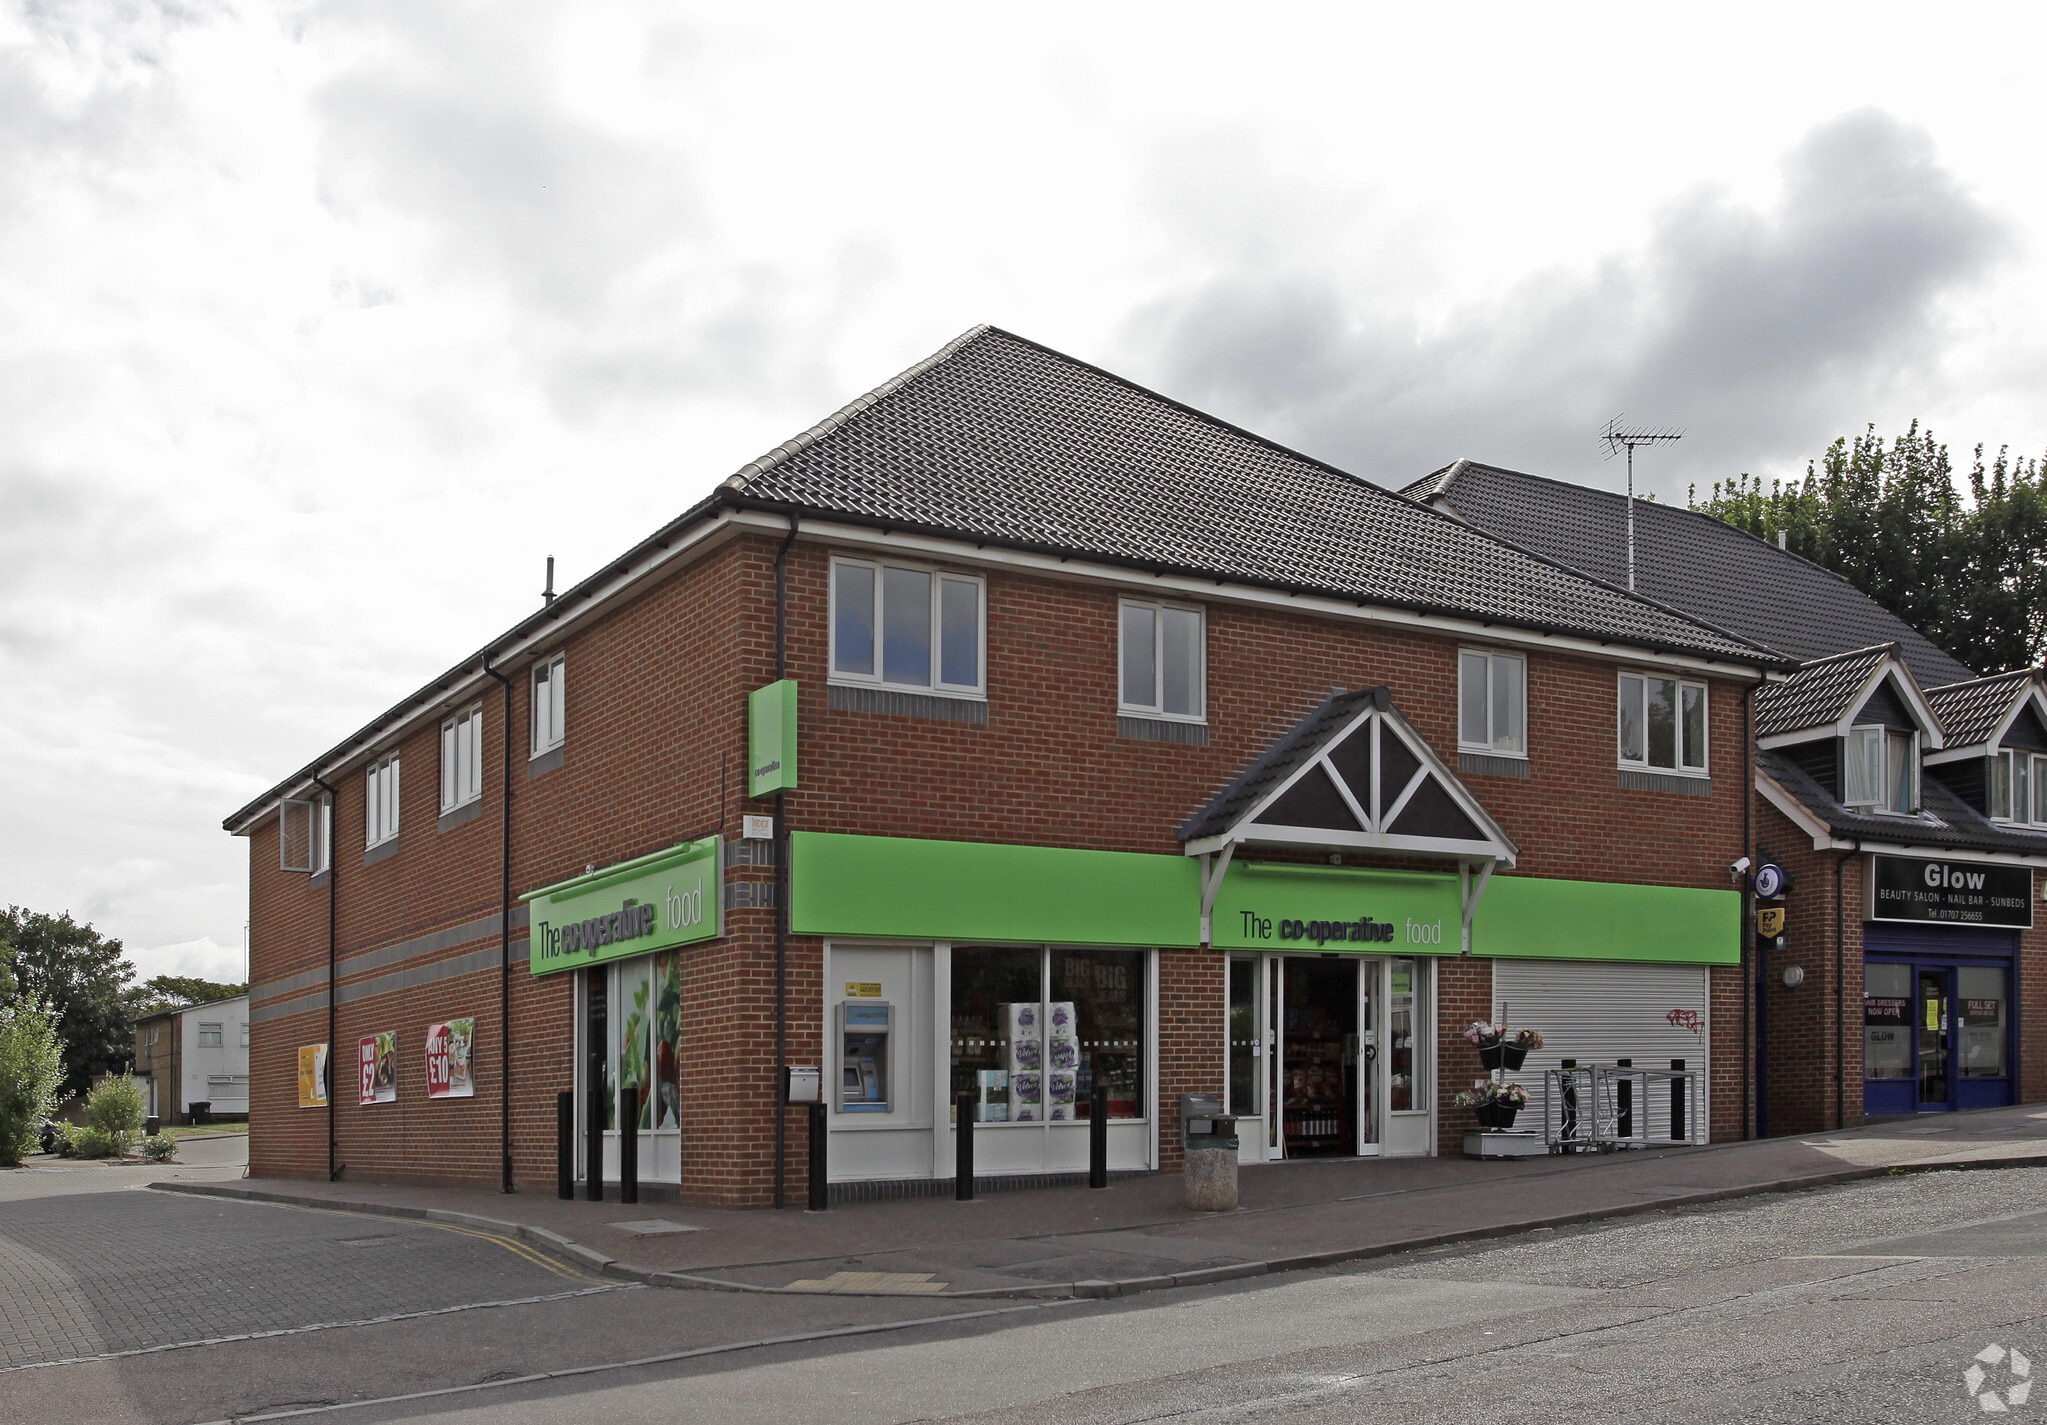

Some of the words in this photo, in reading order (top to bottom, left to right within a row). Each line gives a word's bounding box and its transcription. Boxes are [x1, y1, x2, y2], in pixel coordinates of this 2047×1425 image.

[1924, 864, 1986, 889] Glow
[1880, 889, 1911, 901] BEAUTY
[1914, 891, 1940, 902] SALON
[1948, 894, 1966, 905] NAIL
[1968, 896, 1983, 905] BAR
[1991, 897, 2025, 908] SUNBEDS
[538, 920, 560, 959] The
[561, 898, 655, 957] co-operative
[665, 878, 703, 930] food
[1240, 910, 1272, 939] The
[1280, 917, 1394, 946] co-operative
[1405, 917, 1441, 944] food
[1065, 957, 1090, 977] BIG
[1095, 965, 1126, 989] BIG
[1868, 1007, 1882, 1015] NOW
[1884, 1007, 1900, 1016] OPEN
[1968, 1001, 1982, 1009] FULL
[1984, 1001, 1997, 1009] SET
[428, 1037, 443, 1054] ANY
[444, 1037, 448, 1053] 5
[1871, 1031, 1895, 1041] GLOW
[362, 1043, 375, 1062] ONLY
[429, 1056, 449, 1084] £10
[362, 1063, 375, 1098] £2
